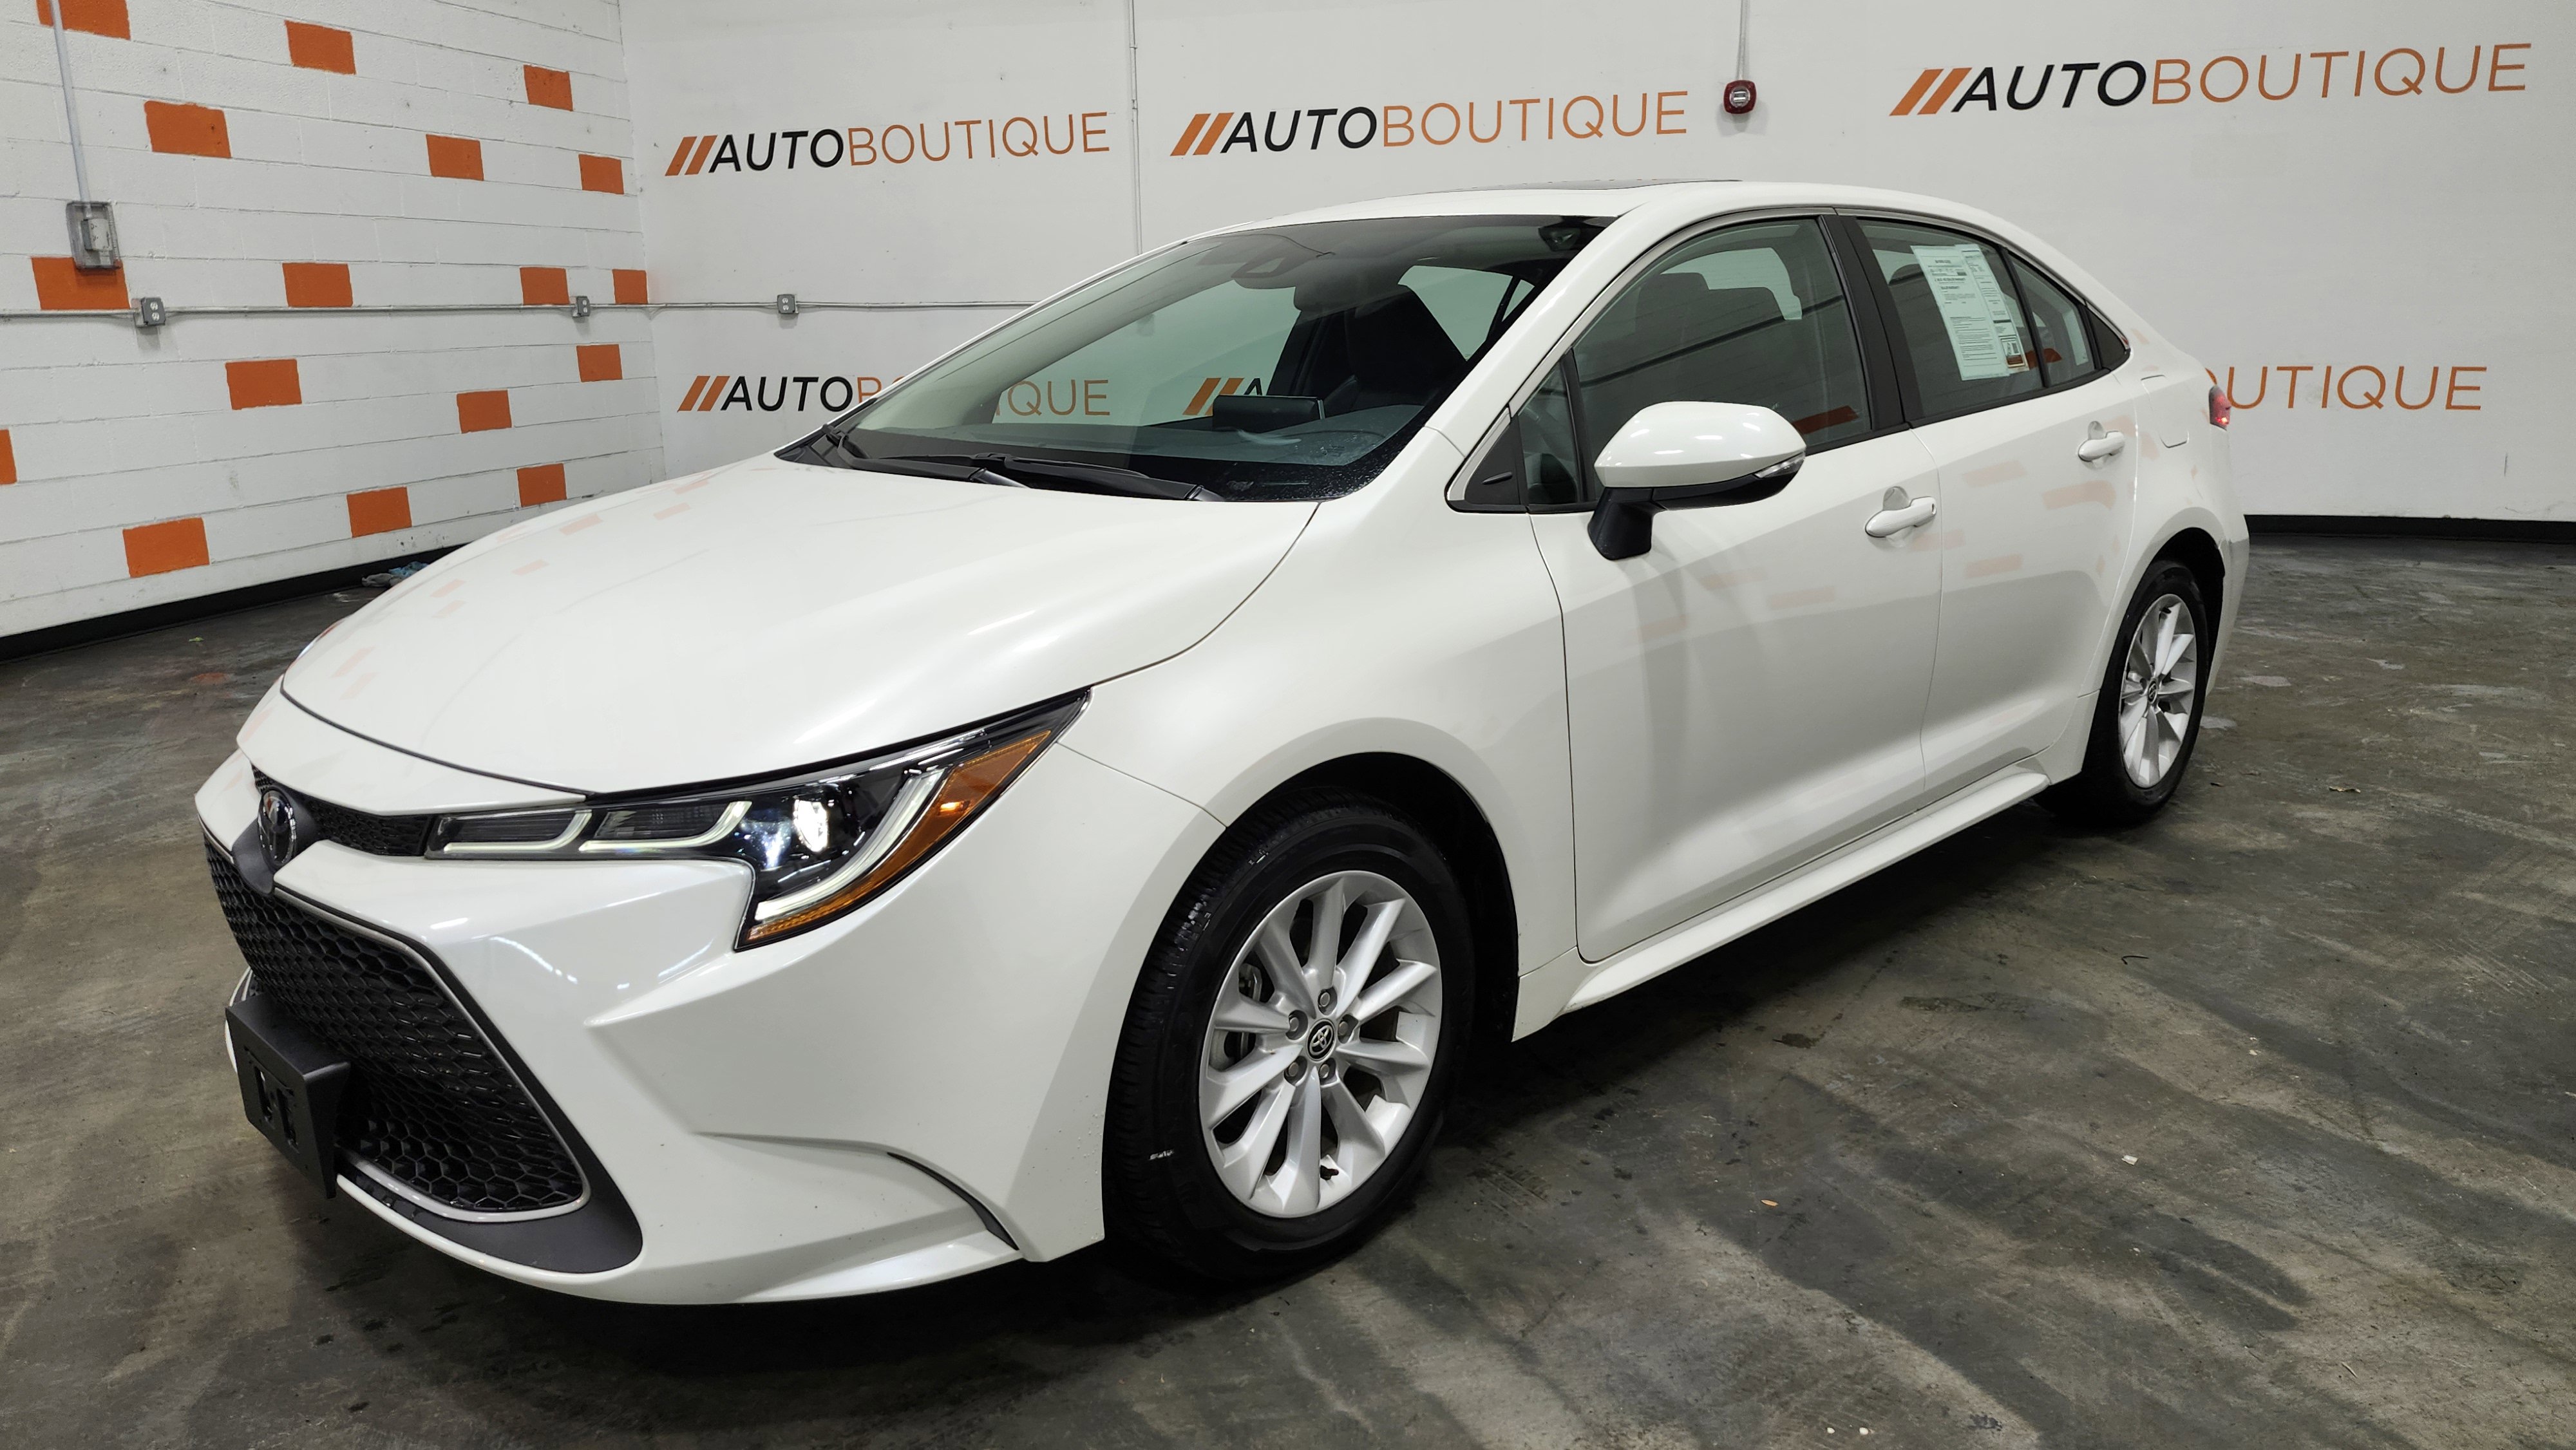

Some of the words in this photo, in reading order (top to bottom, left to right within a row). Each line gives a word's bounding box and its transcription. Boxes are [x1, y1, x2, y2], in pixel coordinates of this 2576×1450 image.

[1952, 44, 2531, 113] AUTOBOUTIQUE
[708, 112, 1110, 173] AUTOBOUTIQUE
[1220, 91, 1688, 154] AUTOBOUTIQUE
[2206, 366, 2487, 410] UTIQUE
